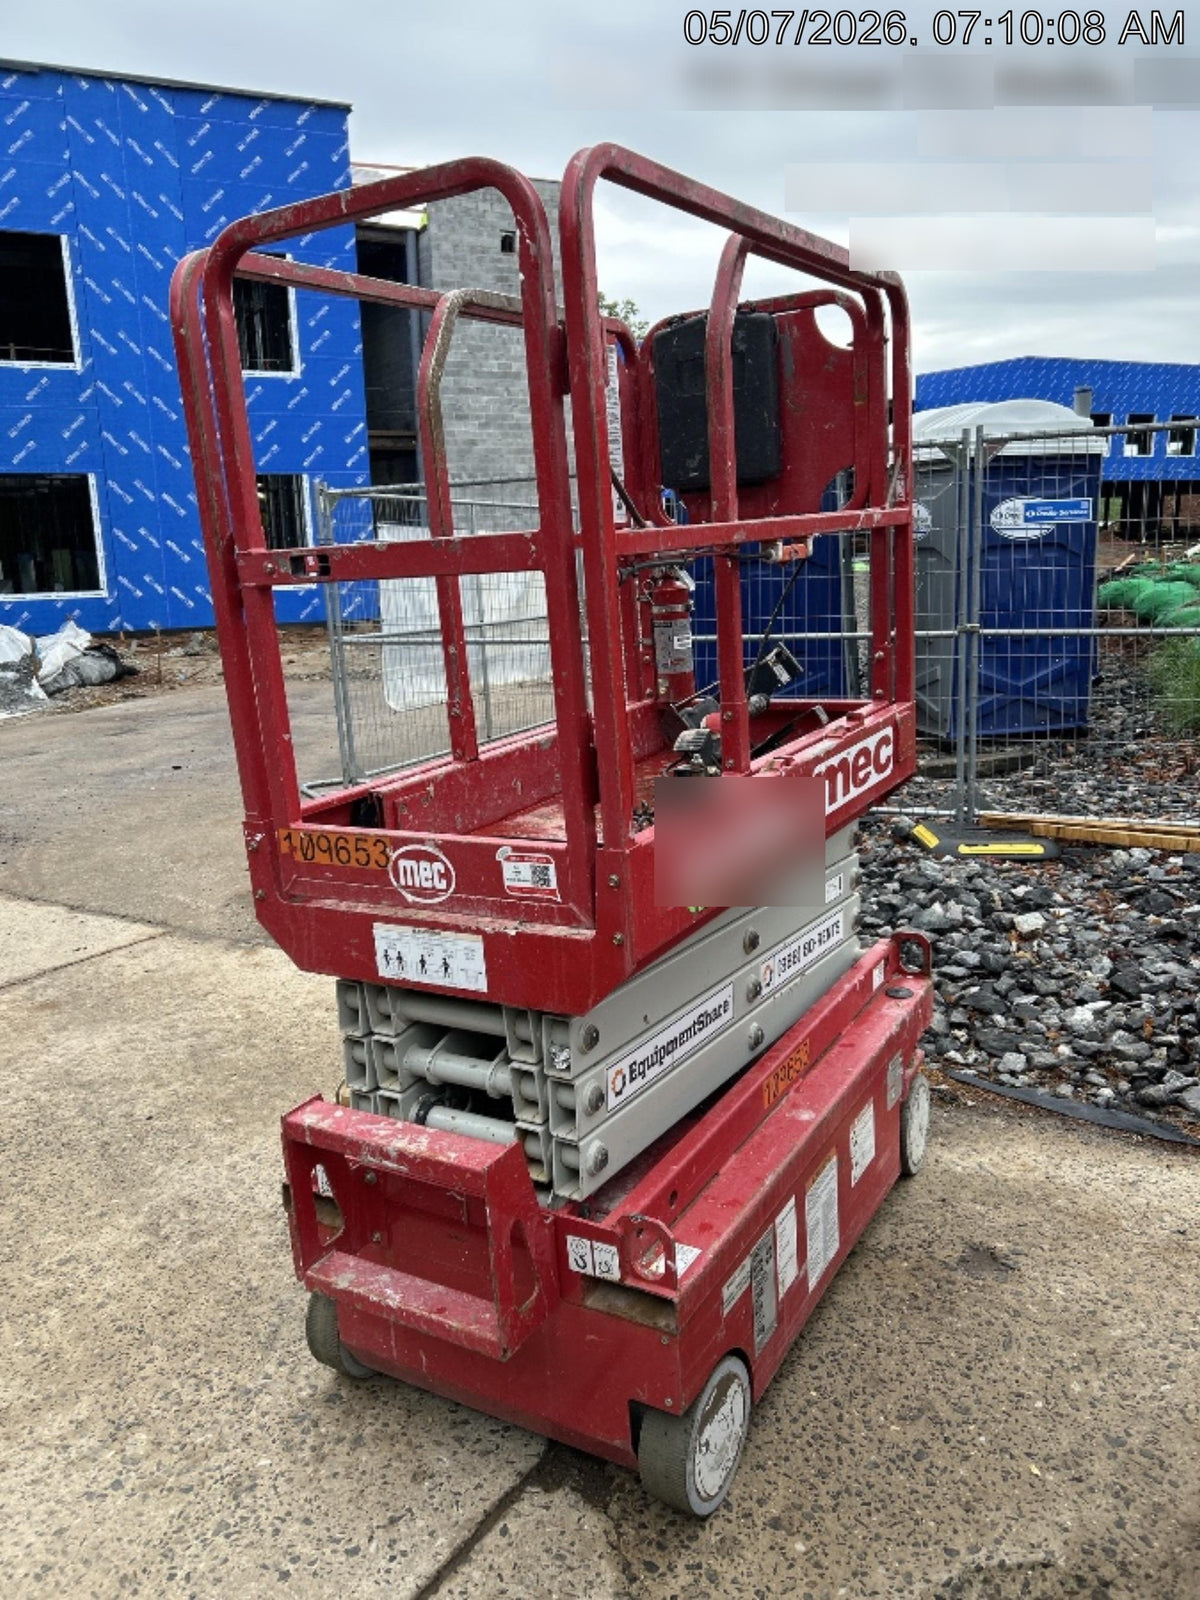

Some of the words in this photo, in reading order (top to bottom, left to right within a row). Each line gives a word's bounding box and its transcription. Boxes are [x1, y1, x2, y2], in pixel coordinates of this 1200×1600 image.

[283, 831, 390, 869] 109653
[398, 859, 447, 891] mec
[628, 999, 730, 1084] EquipmentShare
